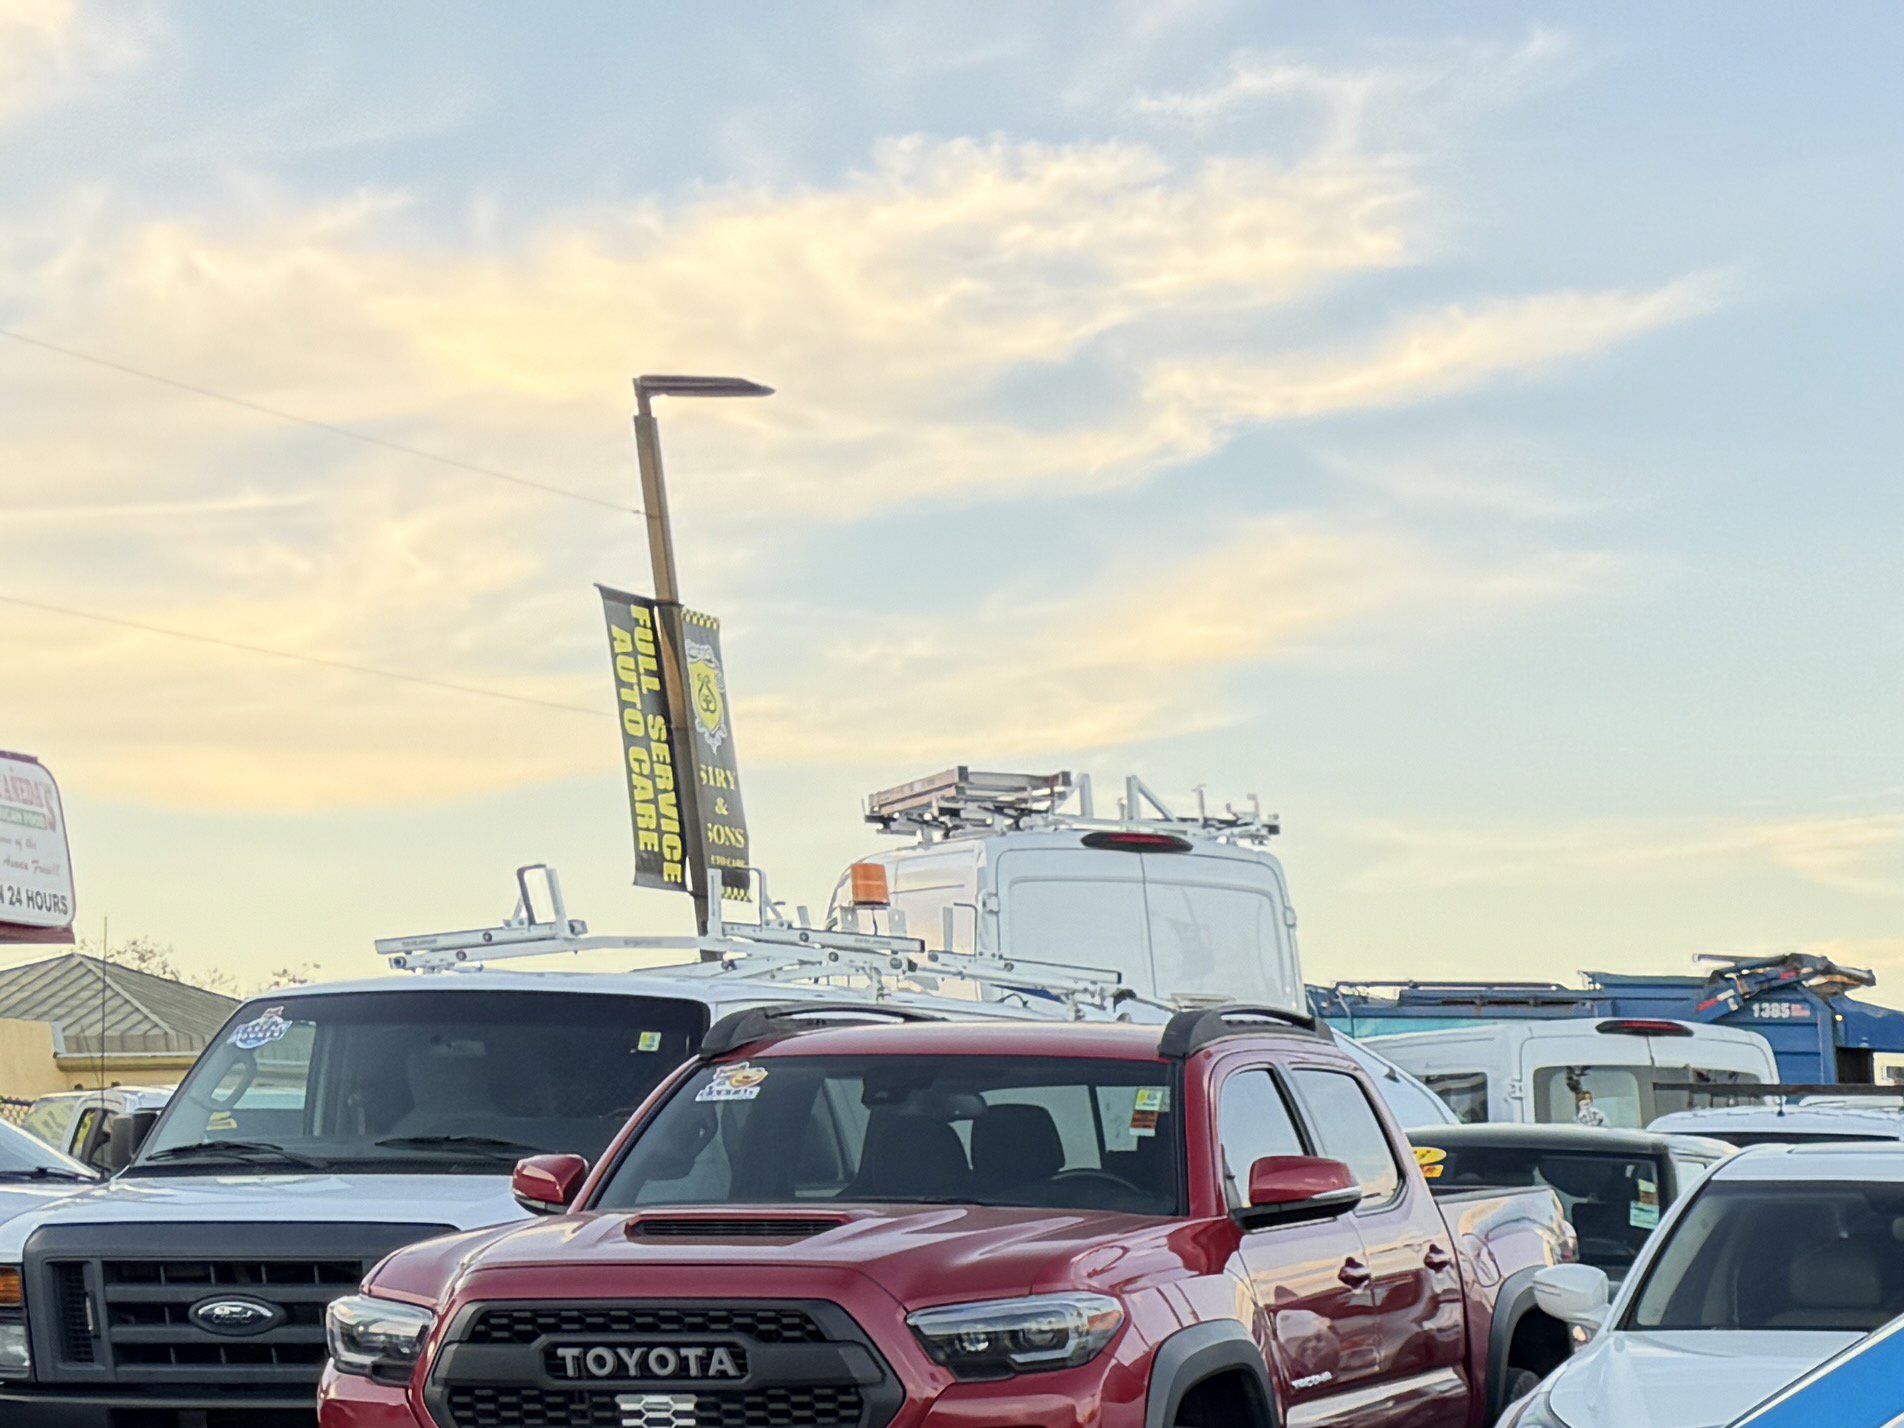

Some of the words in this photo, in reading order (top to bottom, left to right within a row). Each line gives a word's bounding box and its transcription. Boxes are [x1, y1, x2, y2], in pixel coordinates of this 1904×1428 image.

[611, 624, 646, 738] AUTO
[629, 746, 660, 853] CARE
[630, 604, 661, 695] FULL
[647, 714, 683, 884] SERVICE
[714, 797, 729, 815] &
[7, 885, 23, 908] 24
[26, 888, 69, 916] HOURS
[1752, 1002, 1791, 1019] 1385
[556, 1346, 741, 1377] TOYOTA
